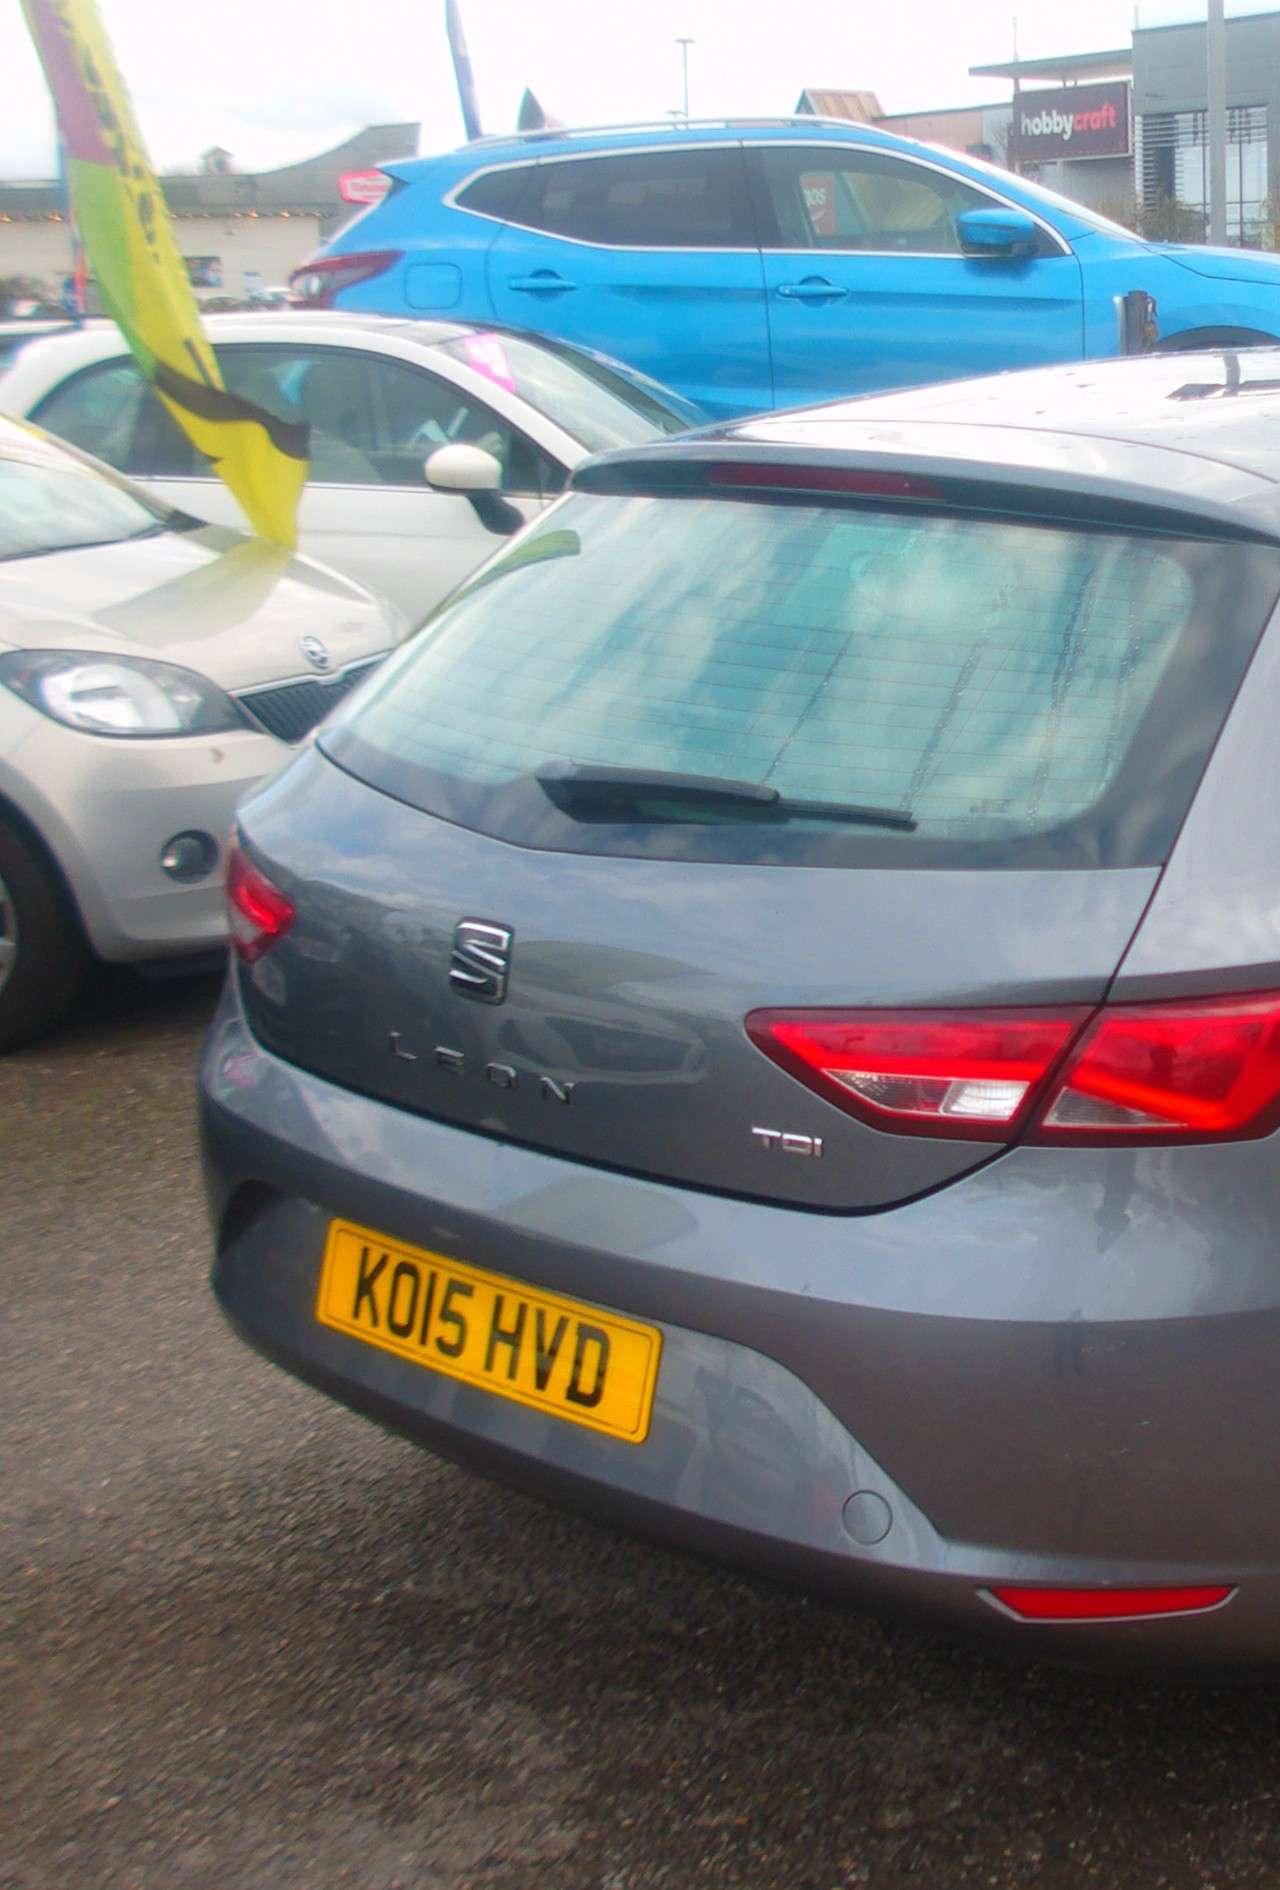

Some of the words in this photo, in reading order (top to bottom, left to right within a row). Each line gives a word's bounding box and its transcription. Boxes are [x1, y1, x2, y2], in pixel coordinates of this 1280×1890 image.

[1021, 102, 1117, 141] hobbycraft
[388, 1031, 575, 1105] LEON
[751, 1126, 824, 1157] TDI
[483, 1294, 611, 1410] HVD
